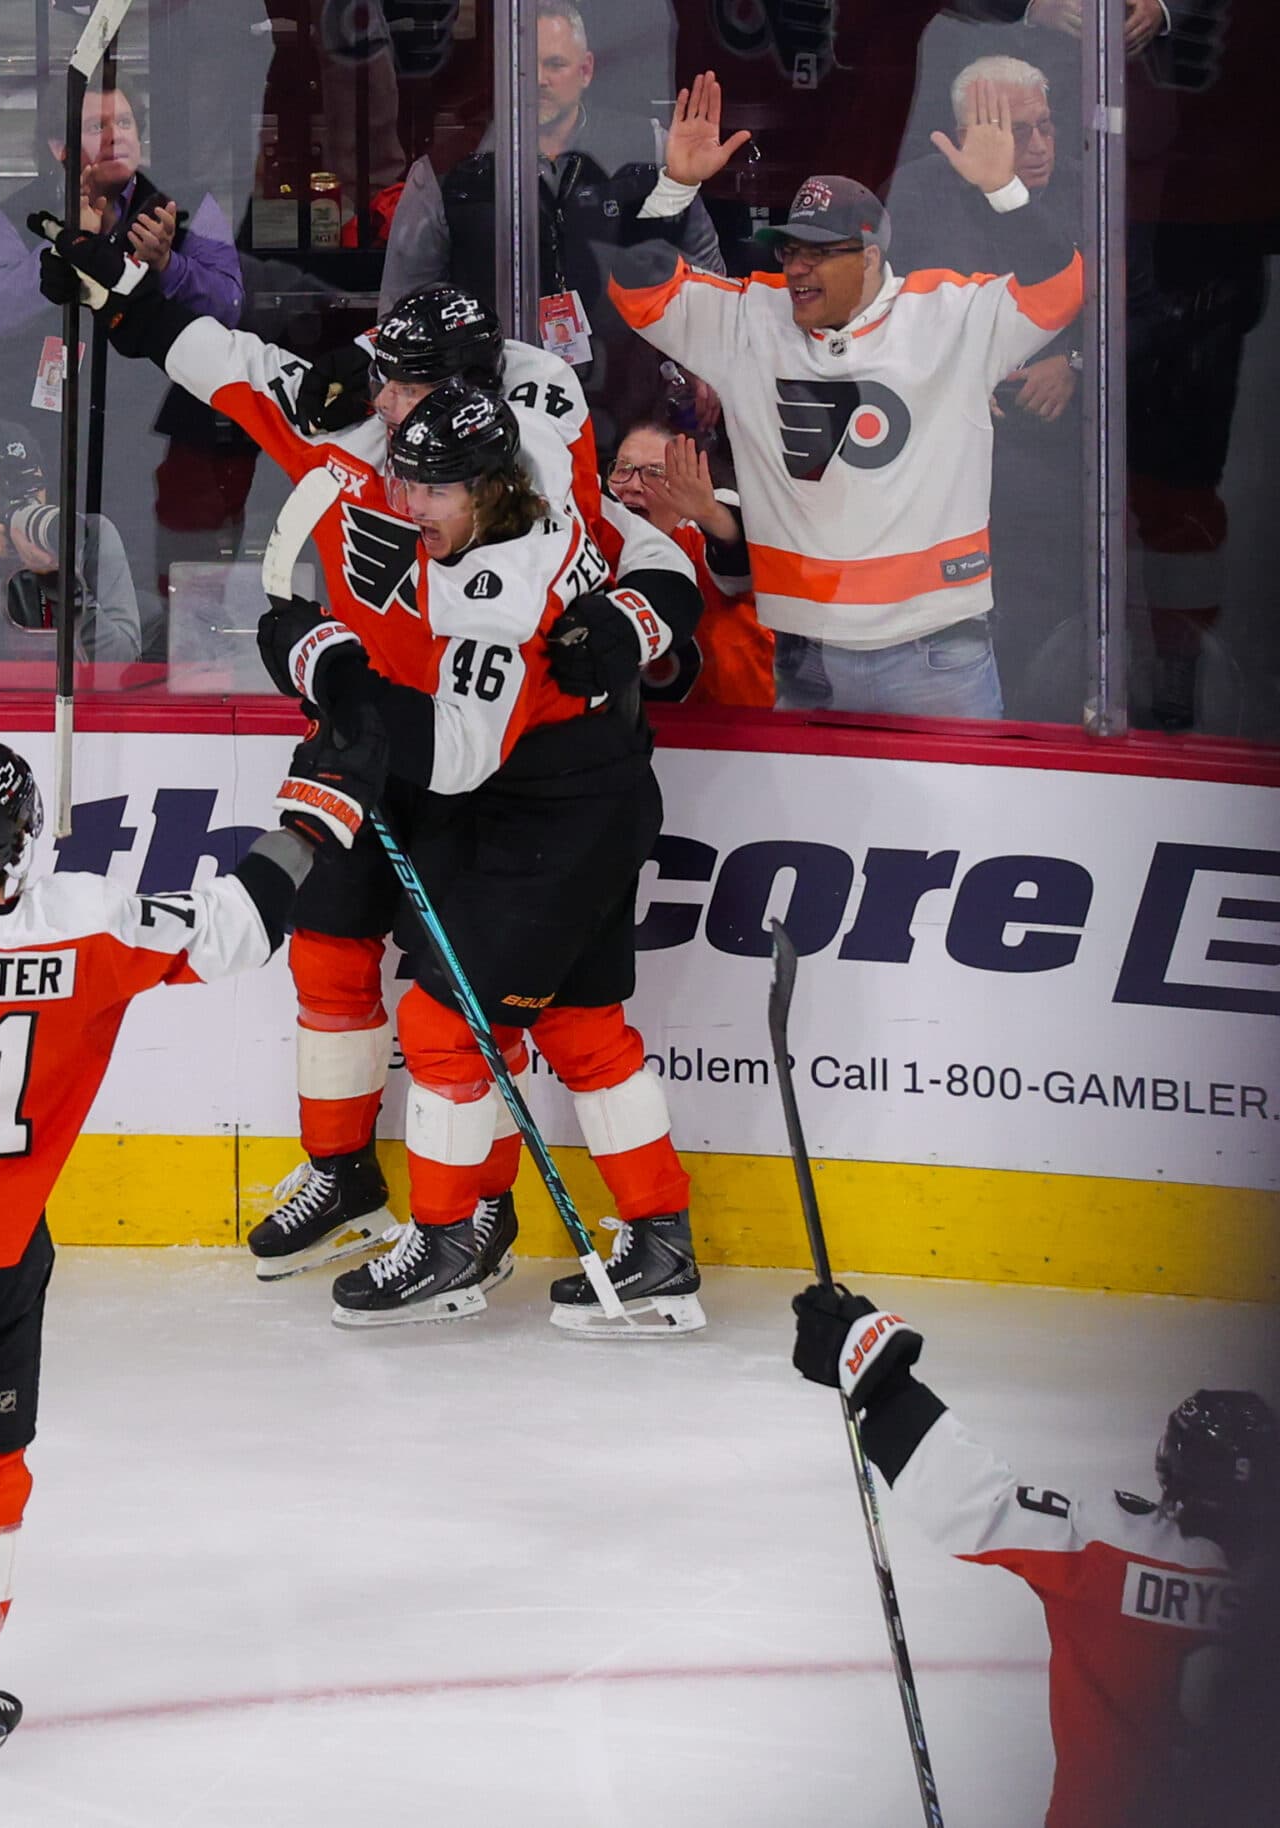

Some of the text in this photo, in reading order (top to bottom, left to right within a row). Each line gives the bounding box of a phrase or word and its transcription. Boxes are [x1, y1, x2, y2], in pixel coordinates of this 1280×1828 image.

[383, 318, 407, 340] 27
[376, 349, 399, 364] CCM
[405, 423, 429, 446] 46
[452, 638, 514, 703] 46
[810, 1054, 888, 1092] Call
[611, 1270, 644, 1294] AUER
